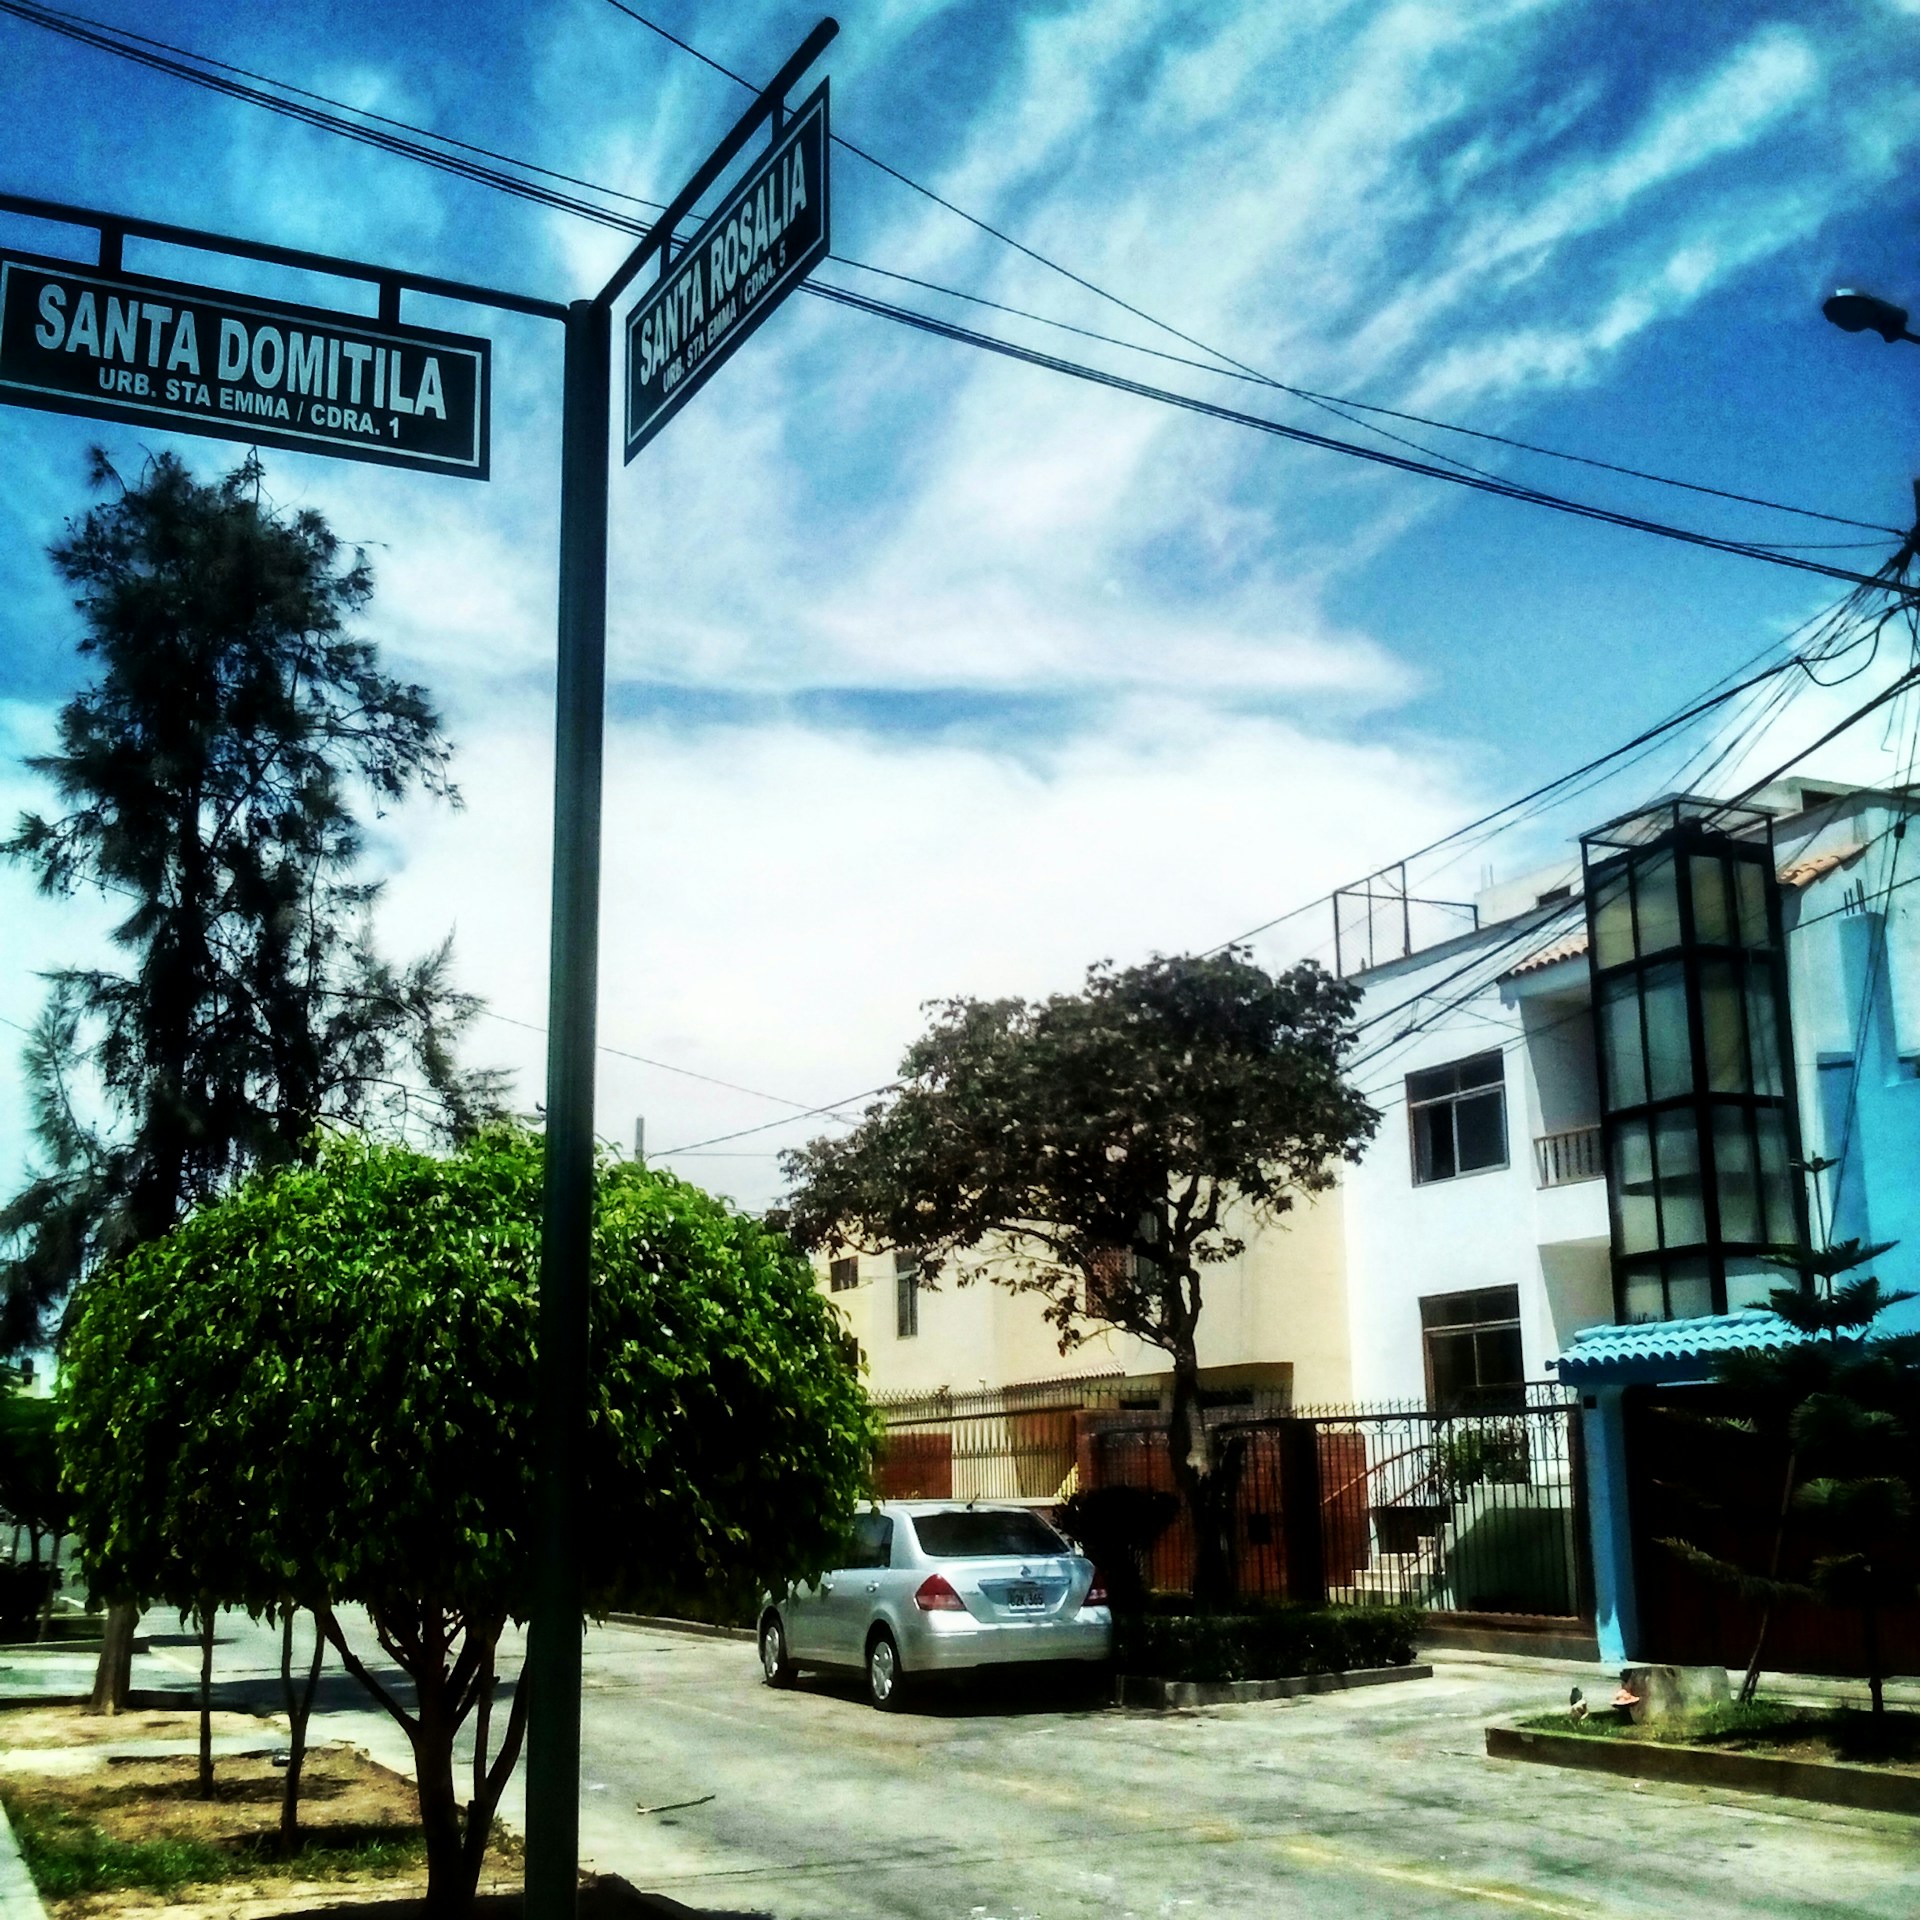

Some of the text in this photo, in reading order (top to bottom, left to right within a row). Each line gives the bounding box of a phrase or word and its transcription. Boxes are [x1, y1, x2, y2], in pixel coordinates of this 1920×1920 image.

[641, 143, 806, 385] SANTA ROSALIA
[663, 356, 684, 392] URB.
[687, 332, 705, 368] STA
[708, 297, 736, 346] EMMA
[745, 257, 776, 304] CDRA.
[779, 240, 786, 268] 5
[36, 284, 446, 420] SANTA DOMITILA
[100, 367, 156, 397] URB.
[166, 379, 211, 406] STA
[220, 388, 289, 419] EMMA
[311, 404, 380, 435] CDRA.
[390, 417, 398, 438] 1
